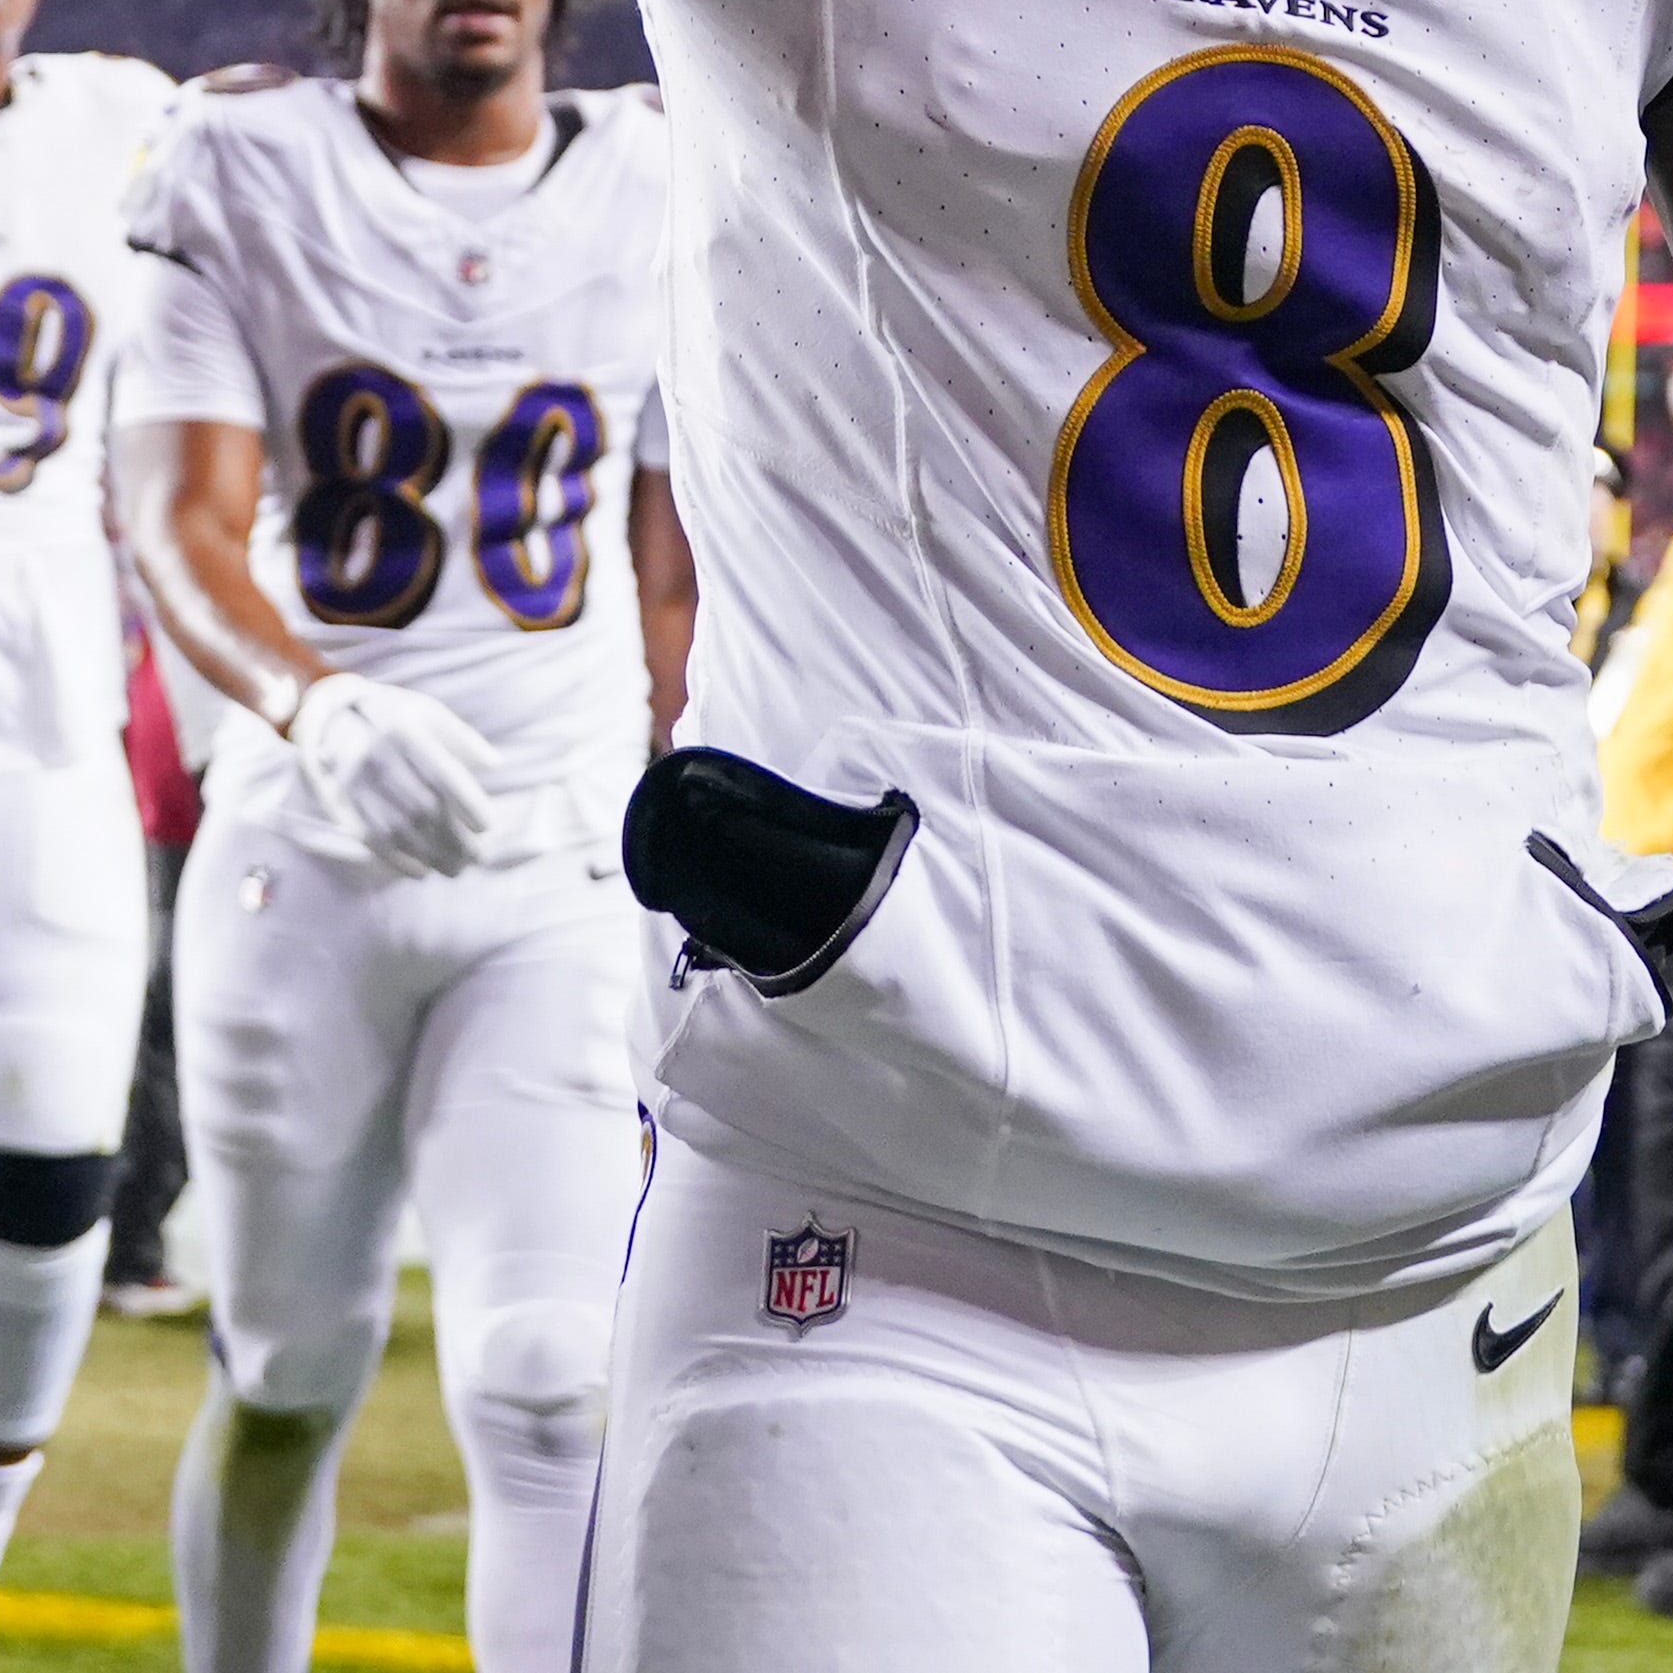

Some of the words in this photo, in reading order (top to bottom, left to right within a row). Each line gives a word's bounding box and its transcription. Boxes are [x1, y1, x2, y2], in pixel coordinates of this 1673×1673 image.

[291, 359, 607, 632] 80
[1047, 42, 1453, 737] 8
[772, 1268, 835, 1313] NFL
